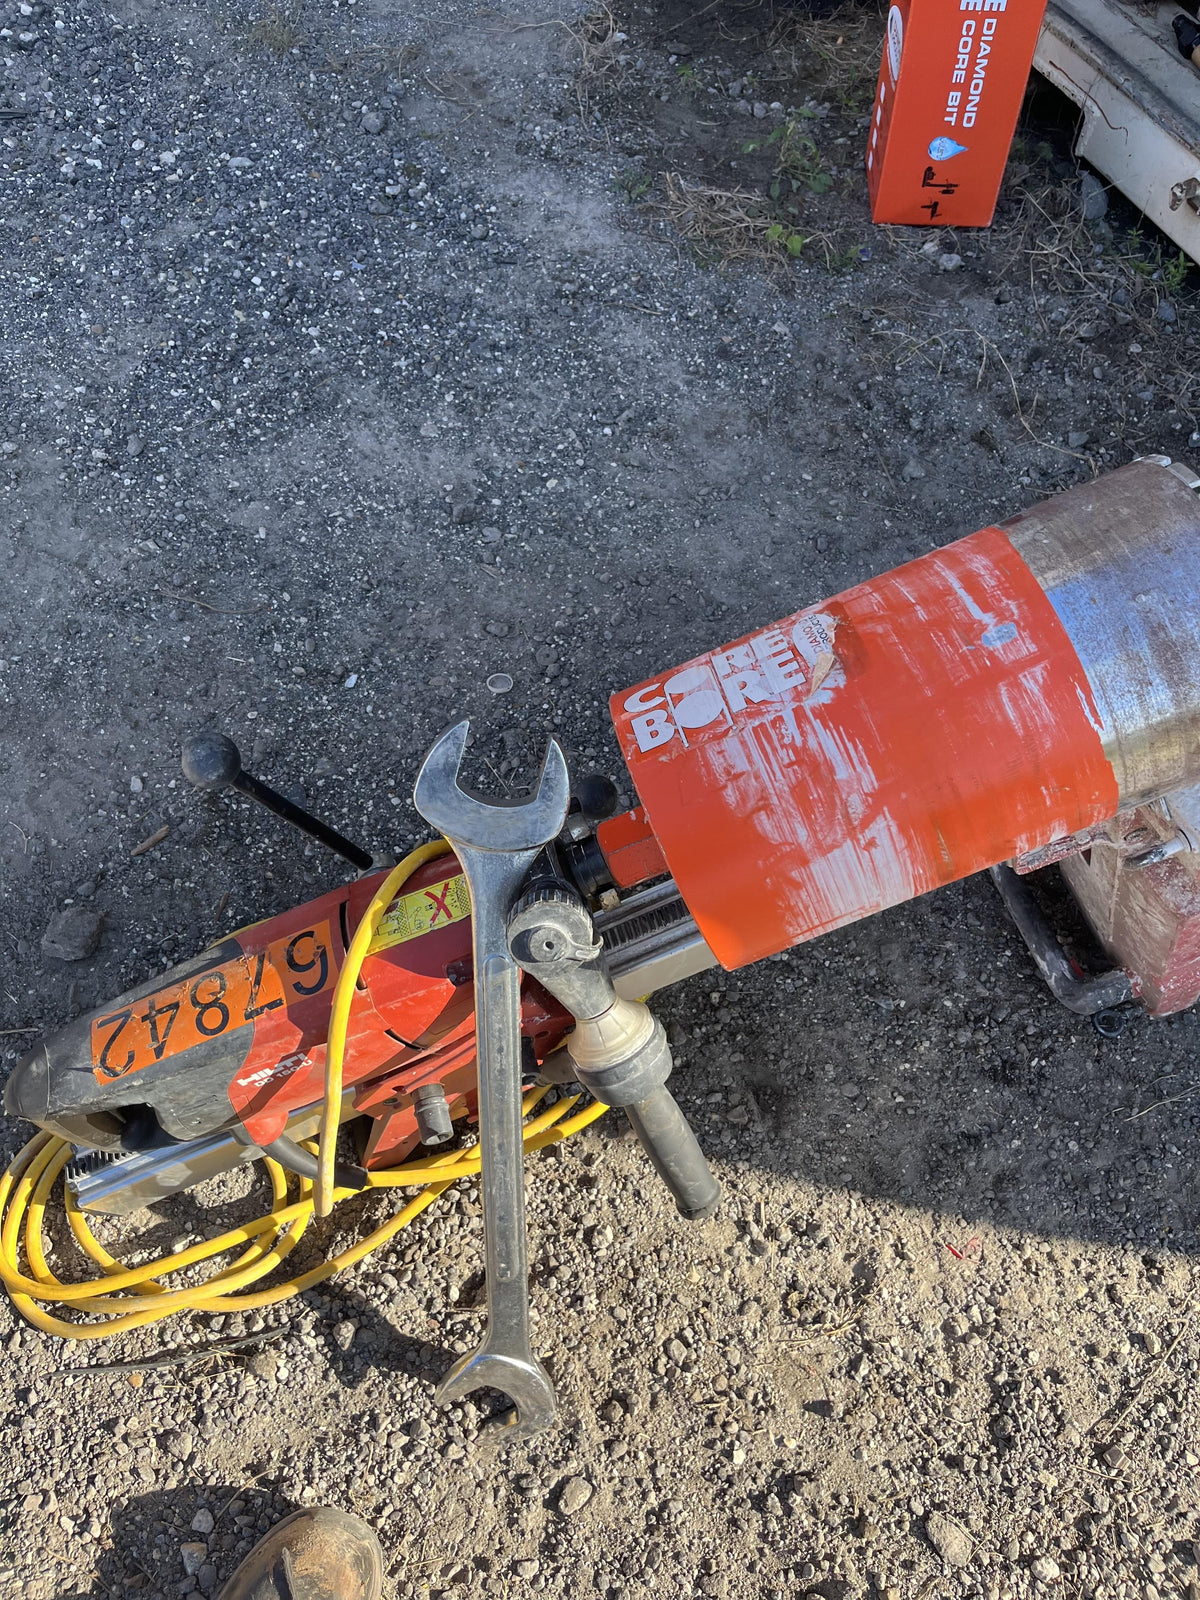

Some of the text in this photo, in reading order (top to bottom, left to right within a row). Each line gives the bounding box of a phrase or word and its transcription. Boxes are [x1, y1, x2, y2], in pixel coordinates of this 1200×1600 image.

[952, 19, 976, 83] CORE
[962, 18, 997, 128] DIAMOND
[944, 91, 962, 126] BIT
[623, 628, 790, 713] CORE
[799, 619, 824, 654] DIAMO
[630, 650, 807, 753] BORE
[97, 930, 329, 1078] 67842
[236, 1053, 308, 1087] HILTI
